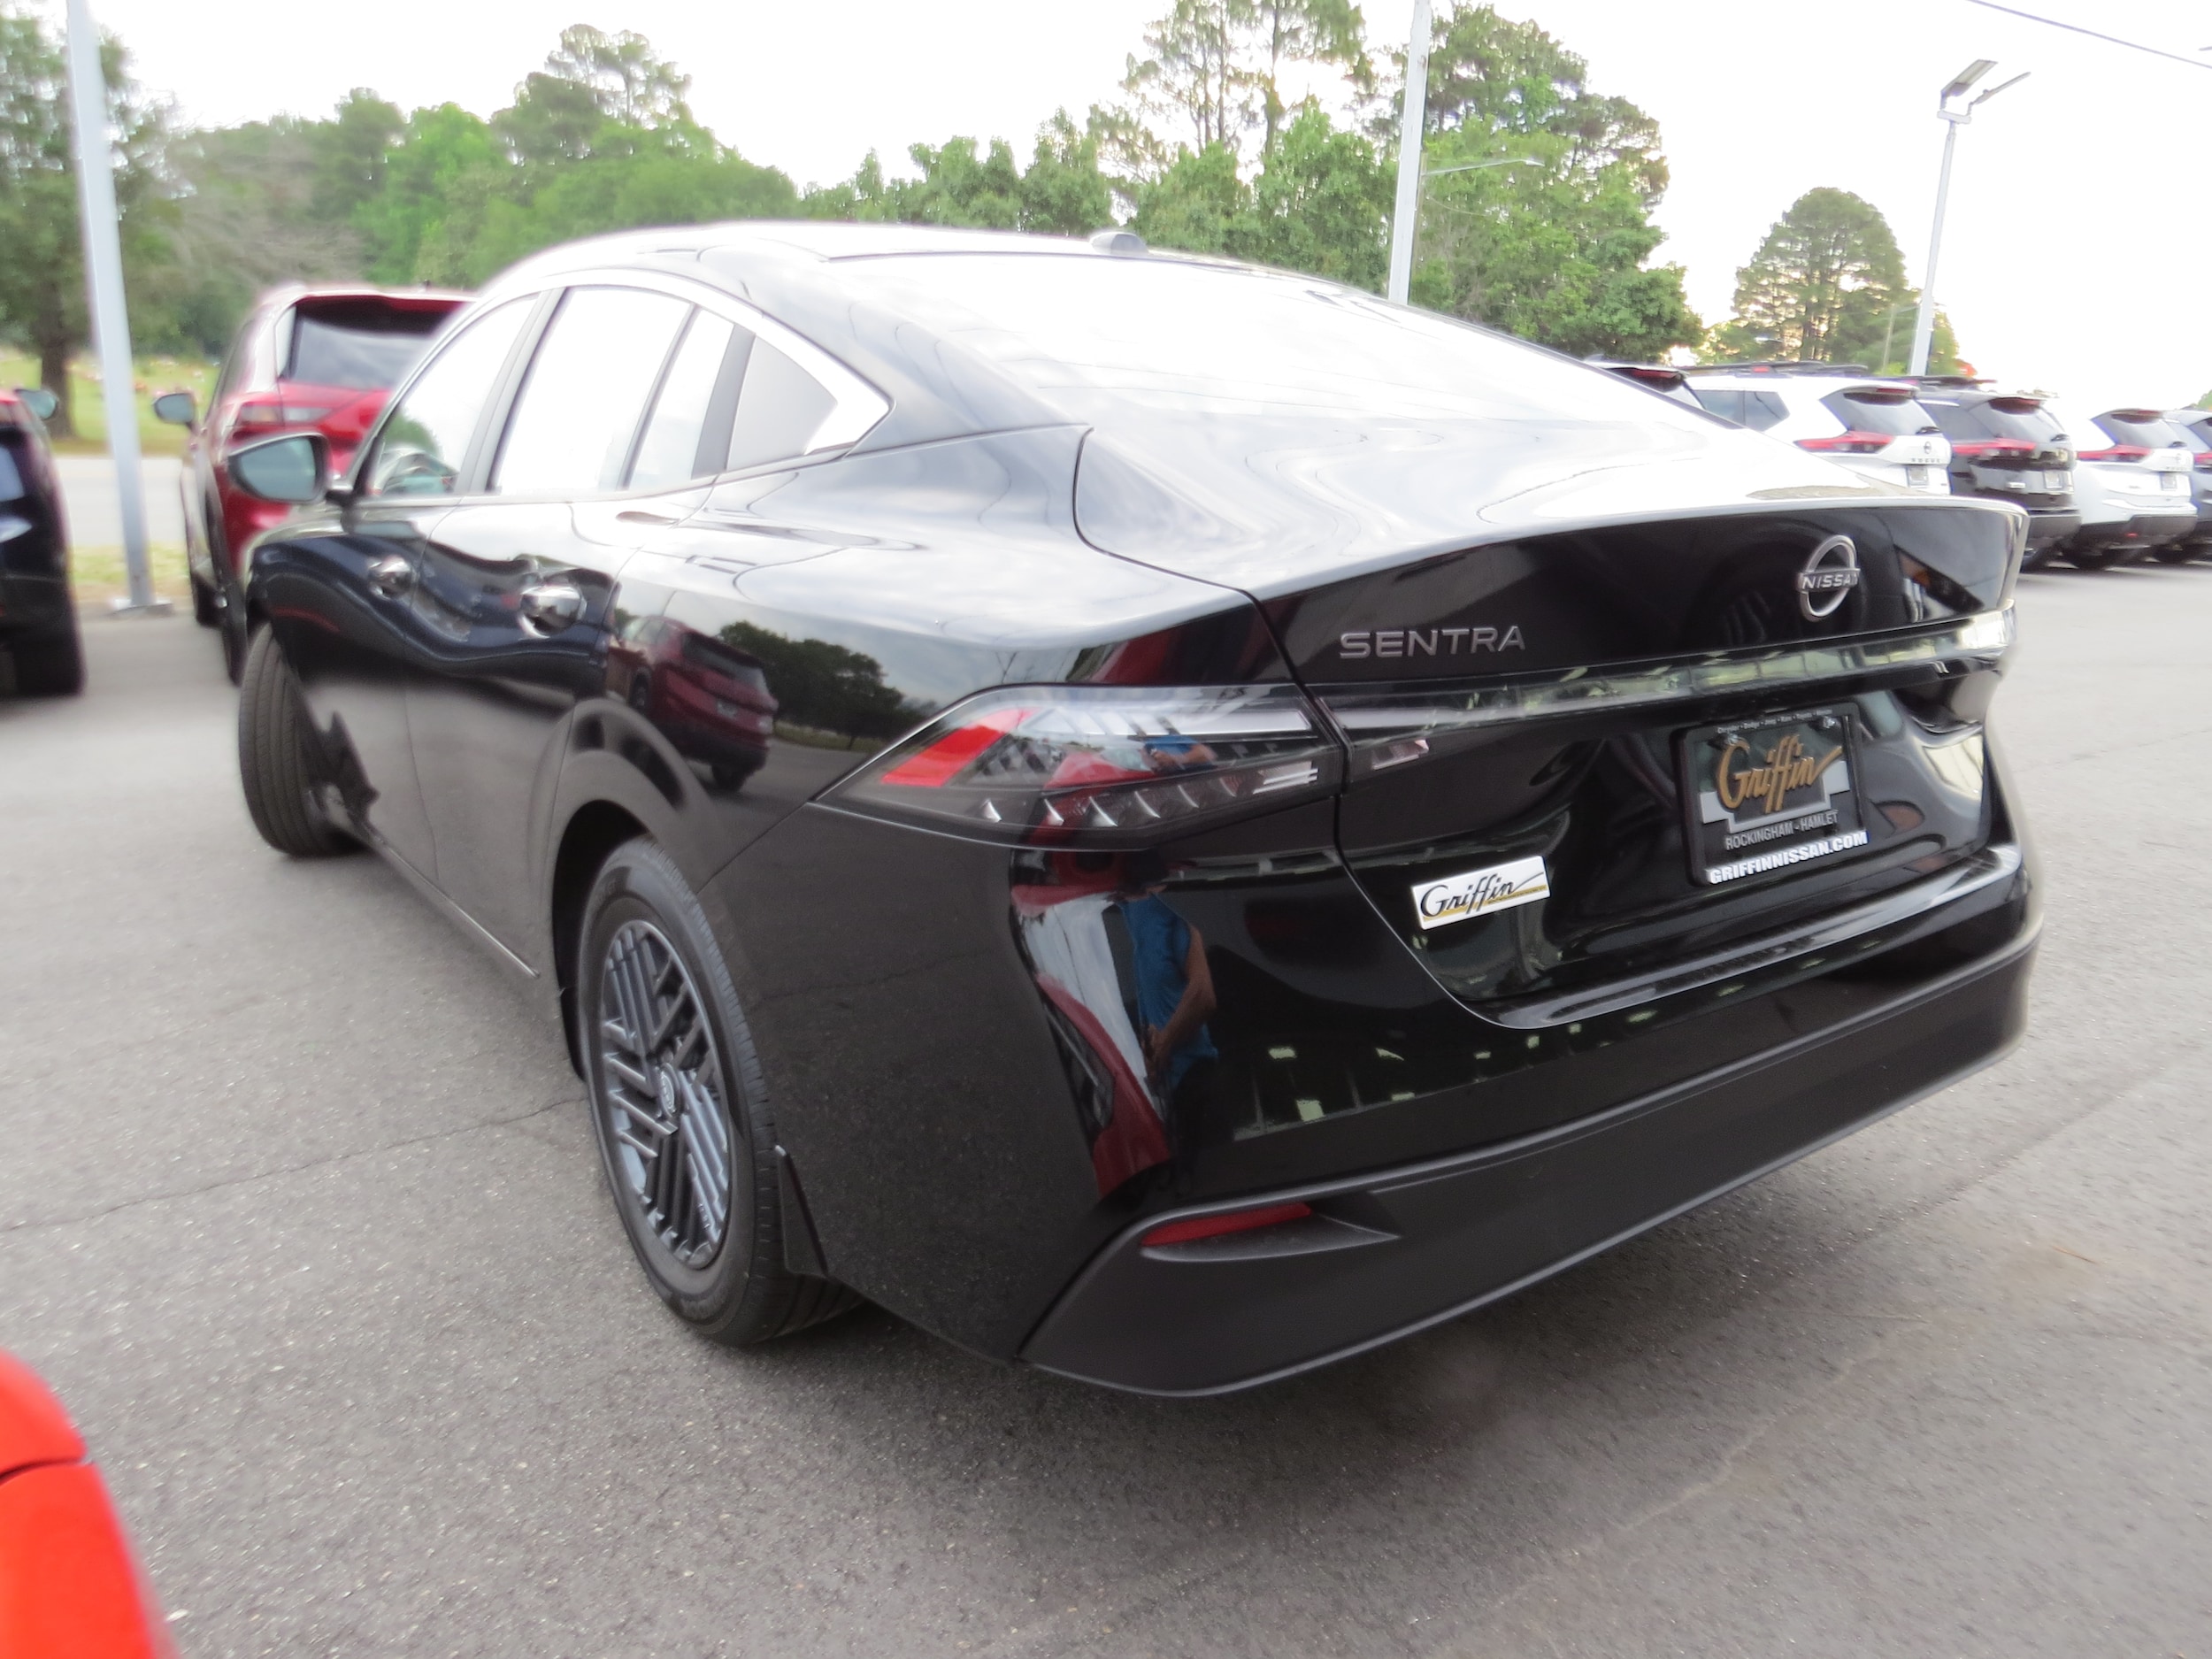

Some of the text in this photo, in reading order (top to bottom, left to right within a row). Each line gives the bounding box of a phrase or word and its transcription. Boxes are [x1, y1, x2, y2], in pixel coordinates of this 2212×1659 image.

[1802, 573, 1858, 589] NISSAN
[1340, 626, 1526, 659] SENTRA
[1717, 733, 1843, 814] Griffin
[1725, 820, 1794, 850] ROCKINGHAM
[1800, 810, 1839, 832] HAMLET
[1707, 829, 1870, 884] GRIFFINNISSAN.COM
[1420, 872, 1544, 918] Griffin
